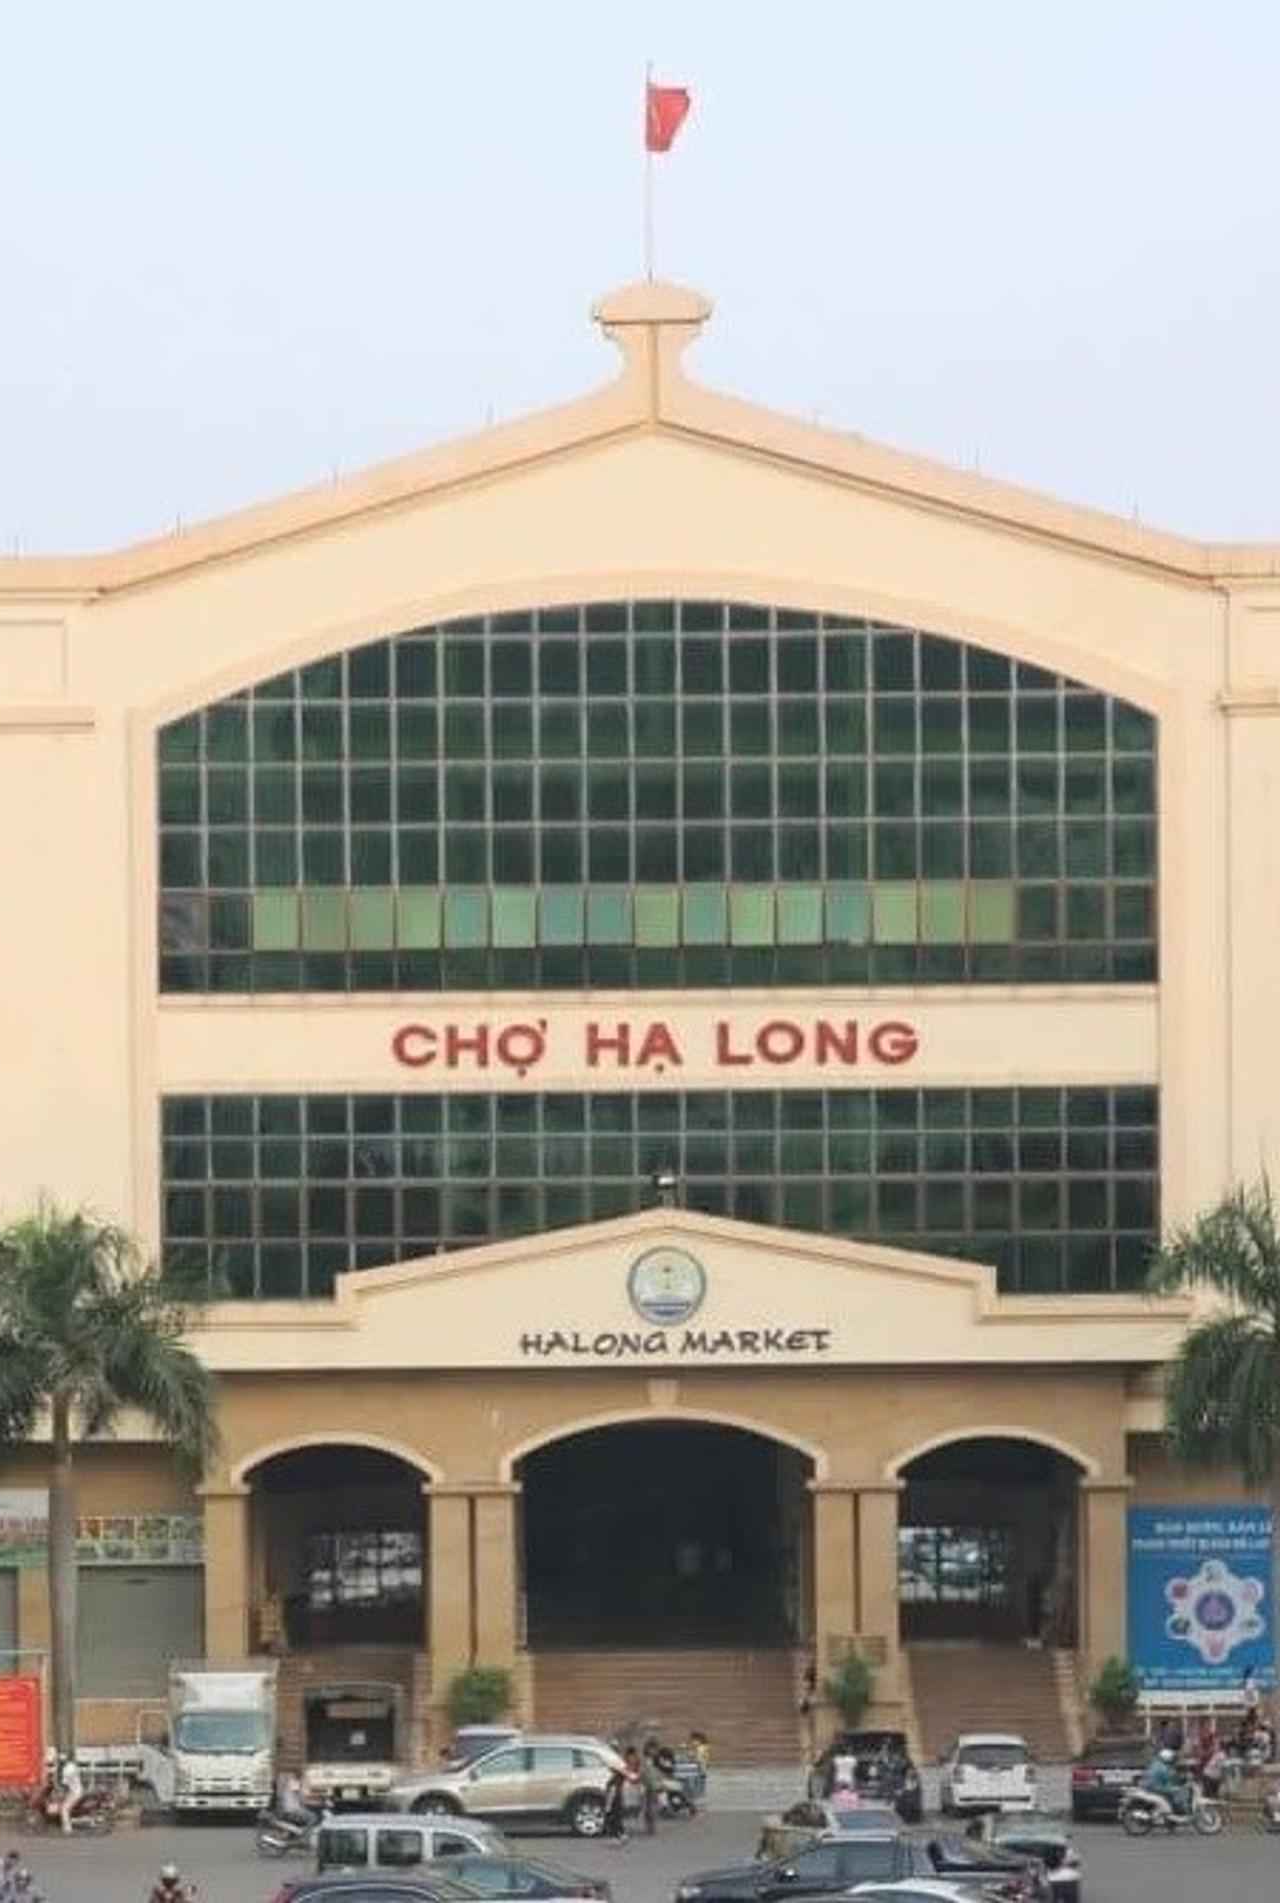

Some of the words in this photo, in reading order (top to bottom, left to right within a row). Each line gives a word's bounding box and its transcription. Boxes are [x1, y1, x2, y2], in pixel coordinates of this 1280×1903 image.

[392, 1019, 547, 1077] CHỢ
[586, 1022, 683, 1072] HẠ
[718, 1020, 919, 1066] LONG
[521, 1332, 667, 1356] HALONG
[681, 1329, 831, 1355] MARKET
